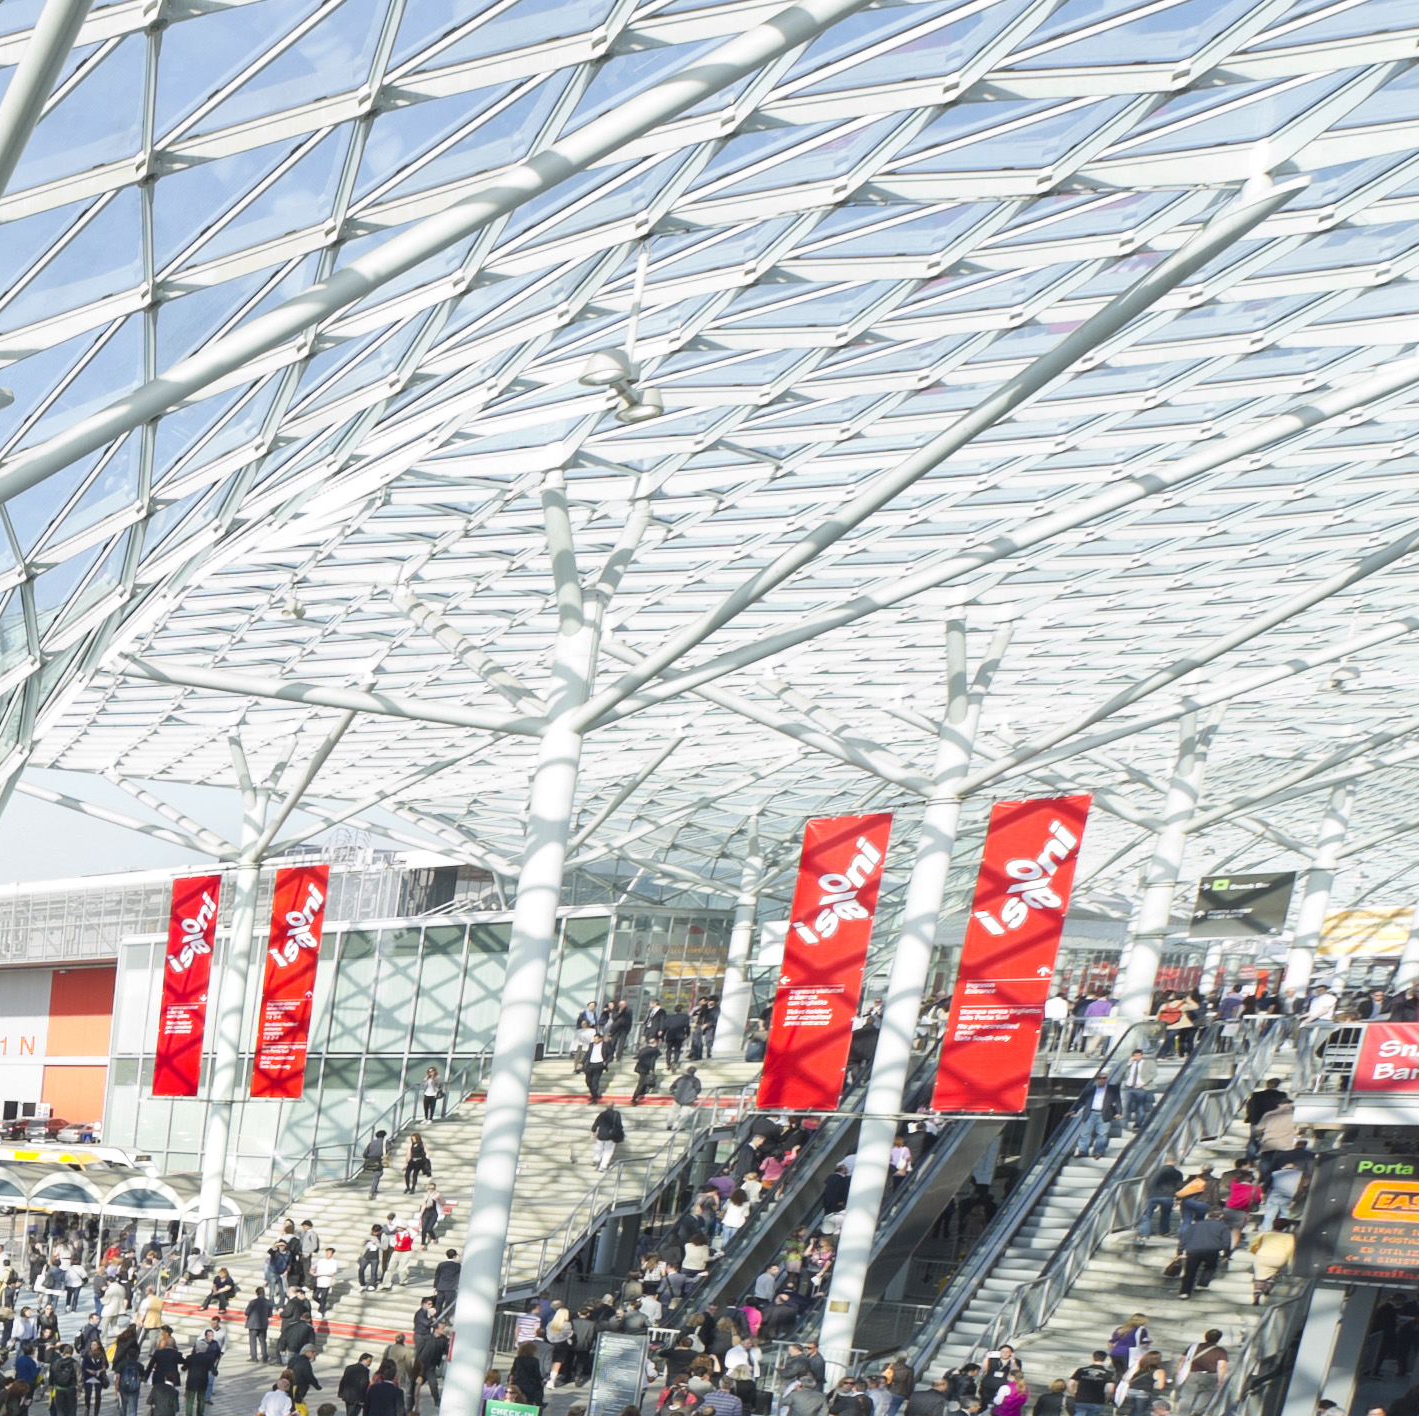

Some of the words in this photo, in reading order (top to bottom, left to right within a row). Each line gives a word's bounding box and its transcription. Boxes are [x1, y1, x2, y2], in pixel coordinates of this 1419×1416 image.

[0, 1037, 9, 1056] 1
[20, 1035, 35, 1056] N
[1358, 1161, 1414, 1174] Porta
